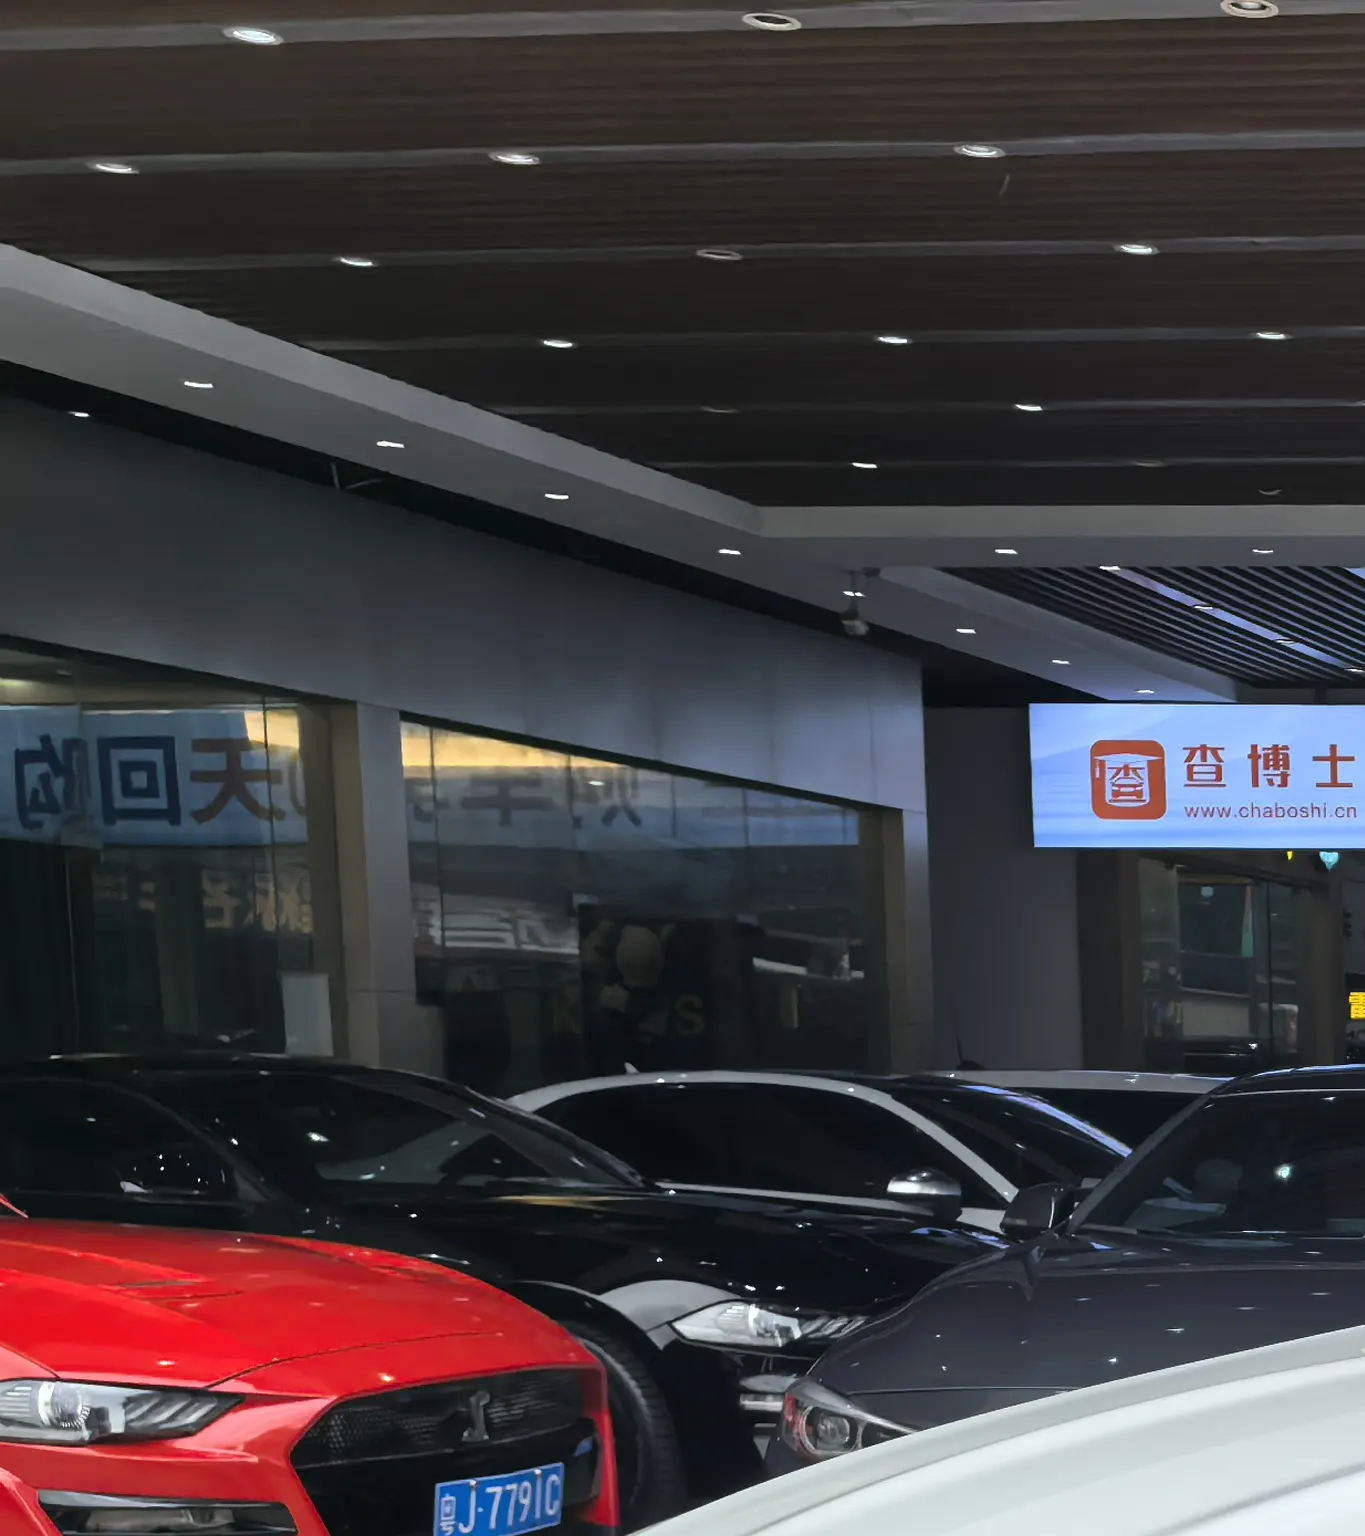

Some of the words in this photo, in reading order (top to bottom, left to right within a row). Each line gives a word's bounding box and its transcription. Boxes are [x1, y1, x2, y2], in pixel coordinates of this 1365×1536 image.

[1183, 743, 1356, 788] 查博士
[1184, 802, 1358, 819] www.chaboshi.cn
